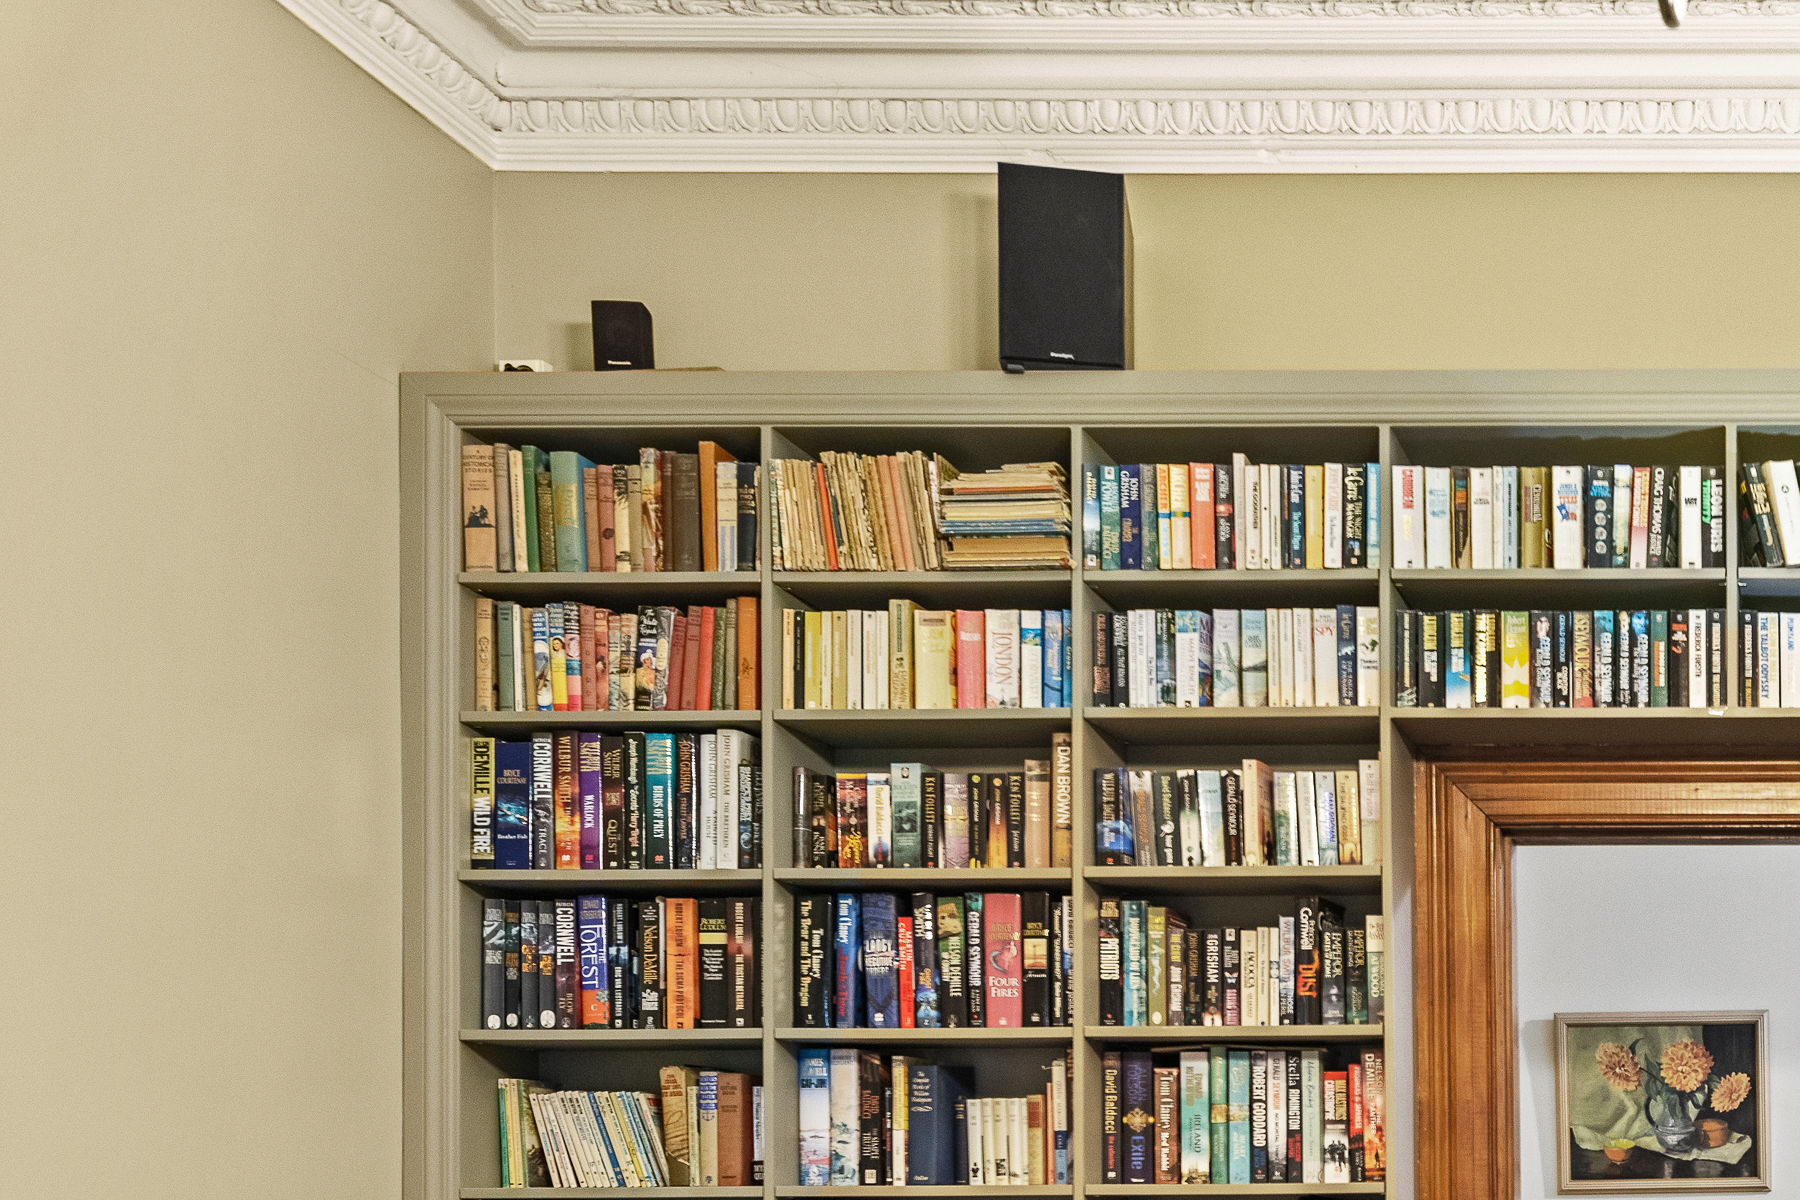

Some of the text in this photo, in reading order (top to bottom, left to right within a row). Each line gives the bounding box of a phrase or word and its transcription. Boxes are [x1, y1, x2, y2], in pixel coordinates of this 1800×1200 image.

[1103, 481, 1112, 513] POWER
[1121, 470, 1131, 509] GRISHAM
[1131, 477, 1139, 502] JOHN
[1711, 479, 1722, 552] LEON URIS
[992, 632, 1014, 686] LONDON
[533, 743, 553, 800] CORNWELL
[559, 737, 571, 803] WILBUR SMITH
[679, 741, 692, 794] JOHN GRISHAM
[722, 735, 731, 796] JOHN GRISHAM
[473, 746, 491, 854] DEMILLE WILD FIRE
[584, 795, 595, 829] WARLOCK
[653, 786, 665, 839] BIRDS OF PREY
[1056, 776, 1071, 824] BROWN
[538, 828, 547, 854] TRACE
[607, 820, 618, 855] QUEST
[557, 907, 574, 965] CORNWELL
[838, 899, 854, 944] Tom Clancy
[1301, 907, 1312, 950] Cornwell
[582, 925, 605, 988] FOREST
[643, 925, 656, 985] Nelson DeMille
[808, 928, 824, 979] Tom Clancy
[950, 936, 962, 996] NELSON DEMILLE
[969, 912, 982, 986] GERALD SEYMOUR
[1100, 937, 1119, 980] PATRIOTS
[1208, 939, 1220, 983] GRISHAM
[1331, 932, 1342, 977] EMPEROR
[988, 977, 1020, 986] FOUR
[990, 987, 1019, 998] FIRES
[1298, 963, 1316, 997] DUST
[1106, 1068, 1118, 1133] David Baldacci
[1288, 1055, 1301, 1130] Stella RIMINGTON
[1366, 1053, 1377, 1099] DEMILLE
[1158, 1074, 1174, 1171] Tom Clancy Red Rabbit
[1252, 1064, 1266, 1146] ROBERT GODDARD
[1131, 1135, 1143, 1169] Exile
[1194, 1113, 1202, 1153] IRELAND
